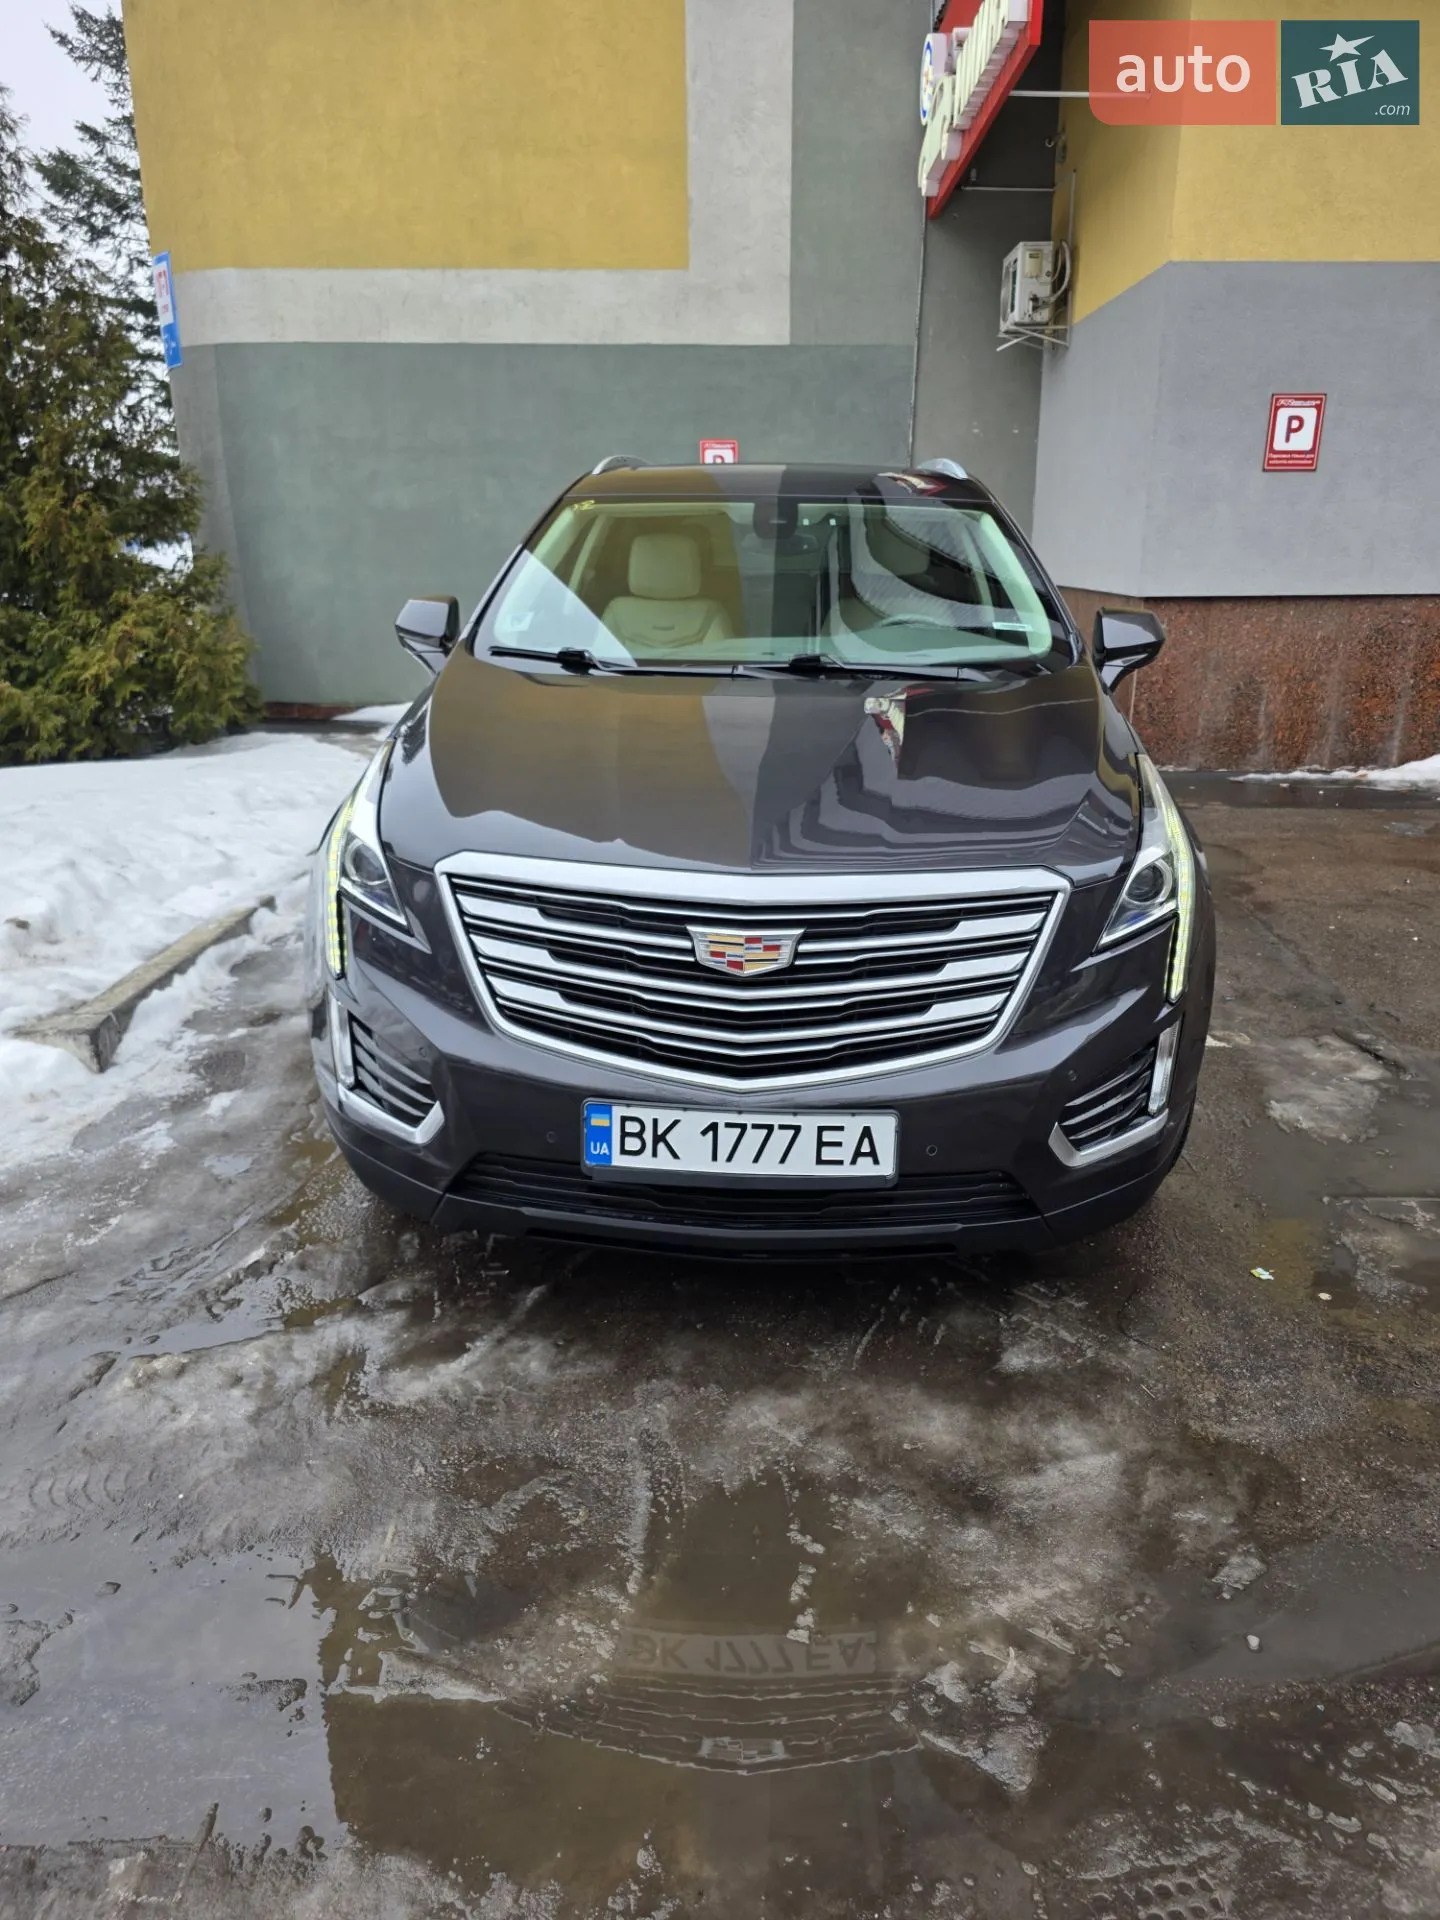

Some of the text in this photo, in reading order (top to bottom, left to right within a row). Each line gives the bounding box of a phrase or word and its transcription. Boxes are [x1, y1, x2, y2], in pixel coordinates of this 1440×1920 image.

[1285, 415, 1304, 443] P
[590, 1143, 610, 1156] UA
[619, 1115, 881, 1166] BK 1777 EA
